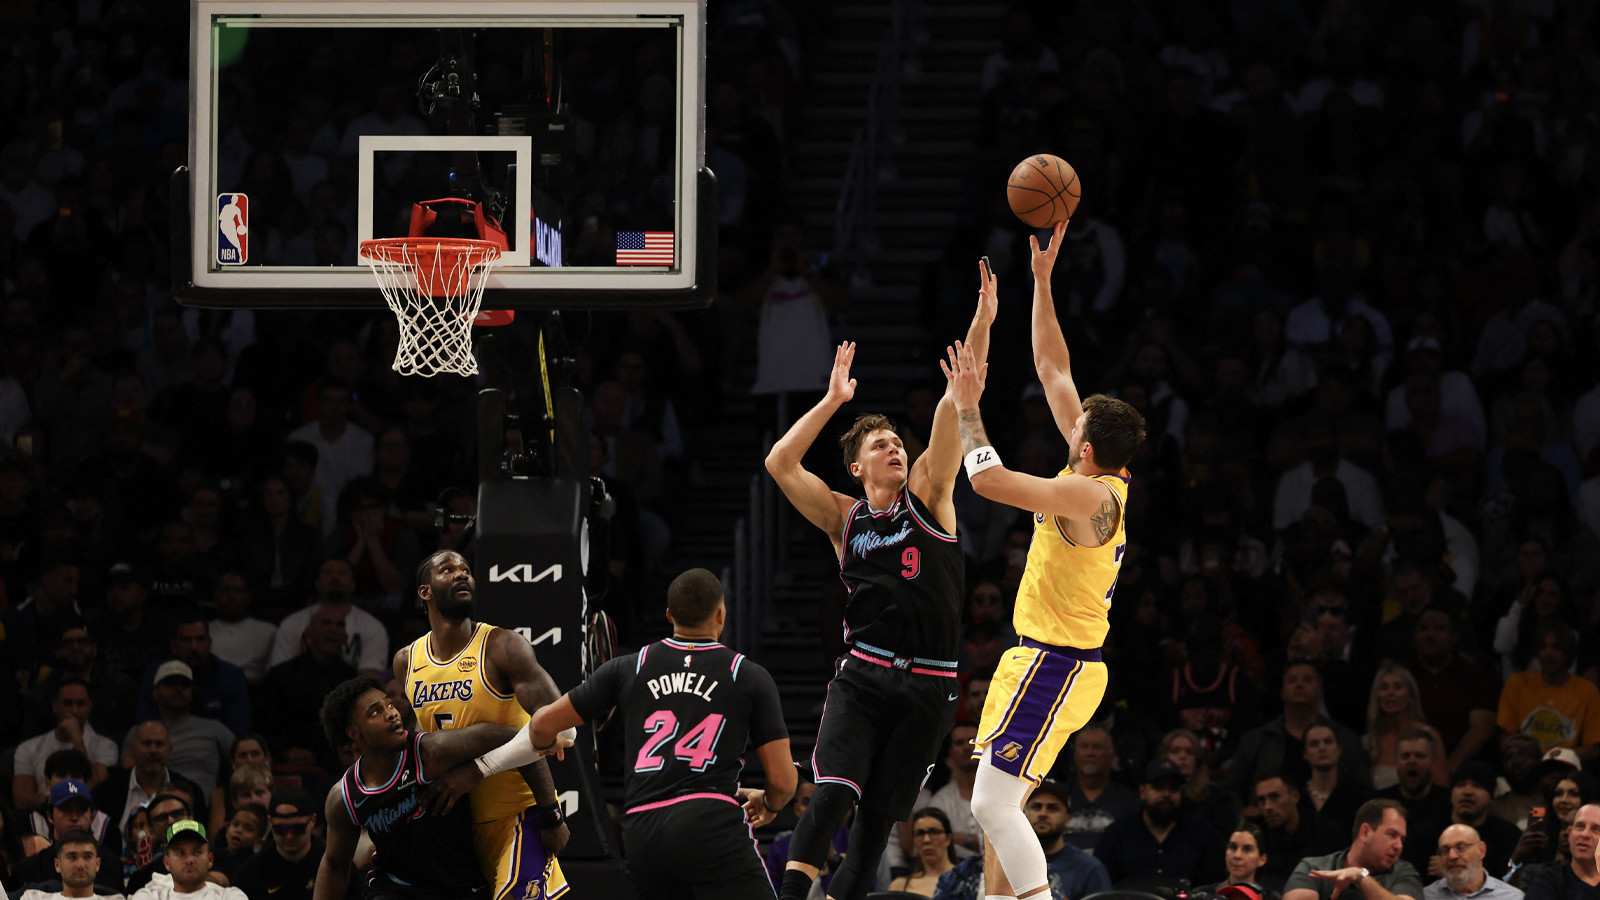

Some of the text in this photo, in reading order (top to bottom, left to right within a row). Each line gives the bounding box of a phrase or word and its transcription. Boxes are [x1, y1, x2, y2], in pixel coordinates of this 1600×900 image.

[221, 248, 237, 261] NBA
[849, 520, 916, 560] Miami
[489, 563, 563, 583] KIA
[901, 546, 921, 580] 9
[412, 679, 474, 709] LAKERS
[646, 671, 719, 702] POWELL
[634, 709, 727, 773] 24
